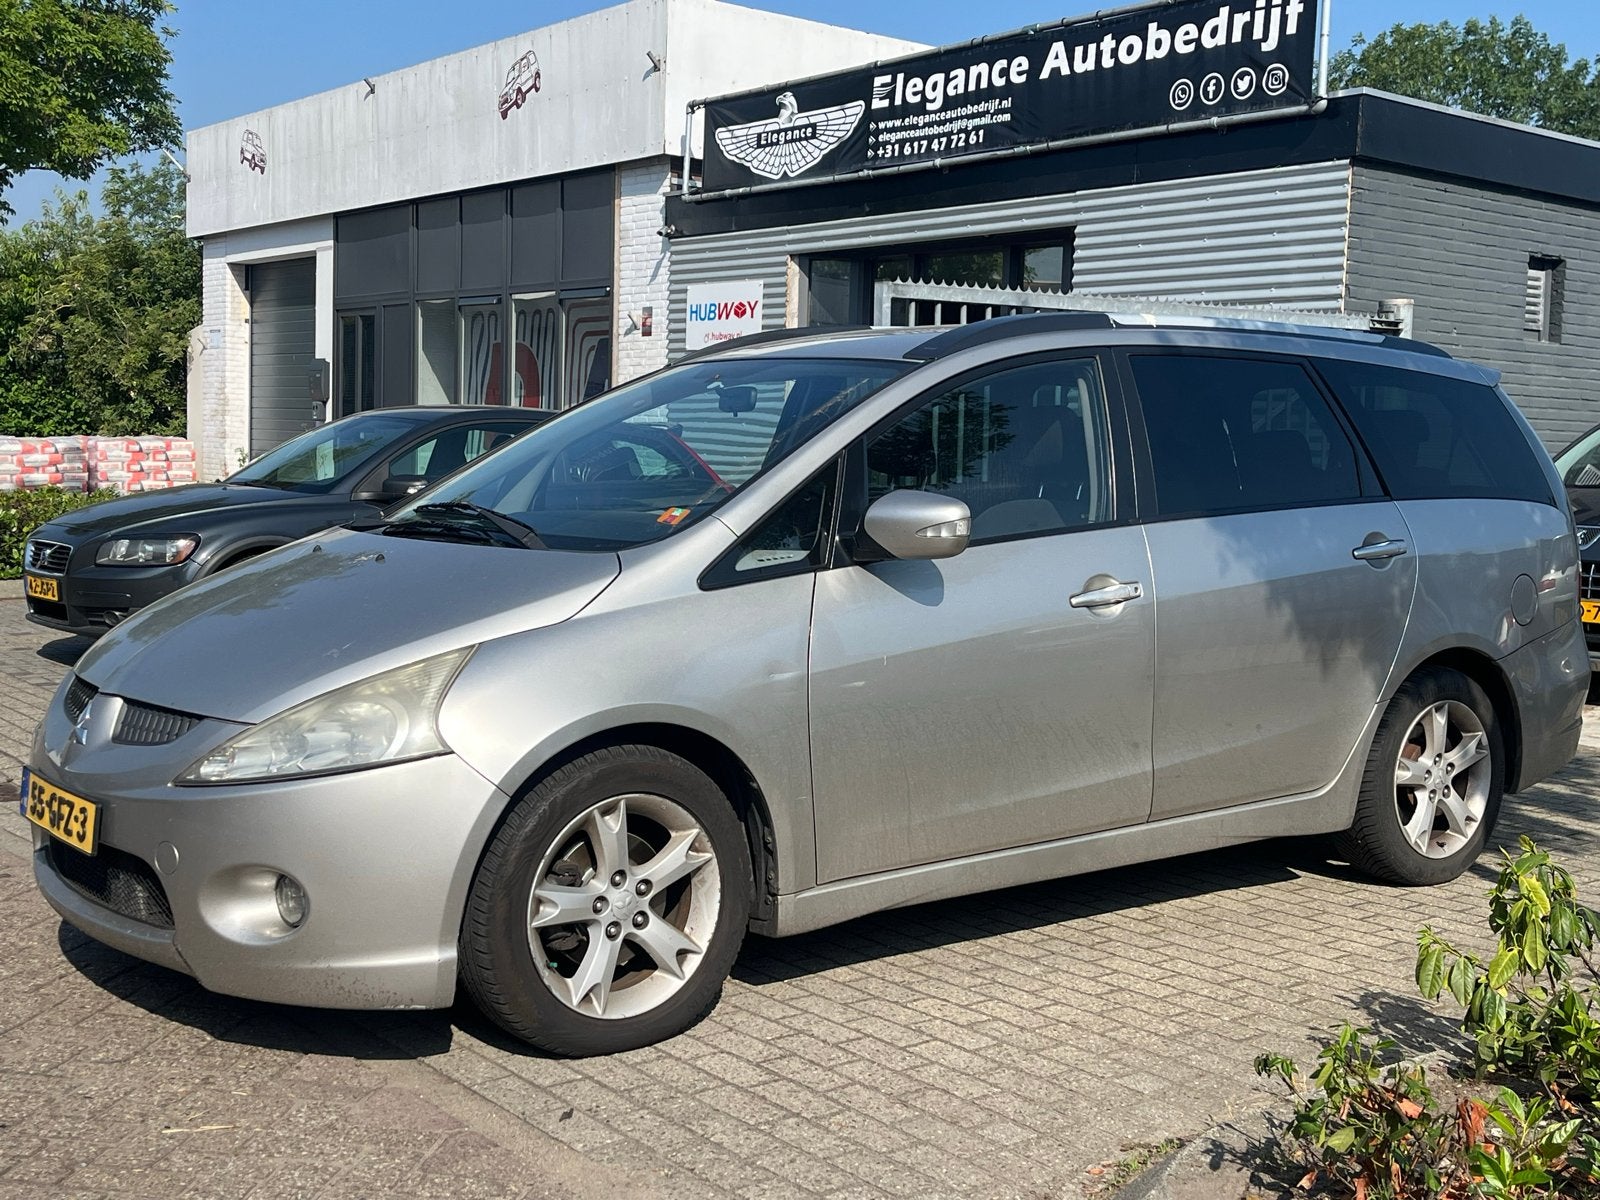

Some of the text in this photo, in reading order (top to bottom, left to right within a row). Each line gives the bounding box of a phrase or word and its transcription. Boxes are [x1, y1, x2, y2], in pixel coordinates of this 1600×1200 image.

[871, 0, 1304, 110] Elegance Autobedrijf
[878, 97, 1012, 129] www.eleganceautobedrijf.nl
[878, 113, 1011, 143] eleganceautobedrijf@gmail.com
[760, 127, 813, 145] Elegance
[877, 129, 984, 158] +31 617 47 72 61
